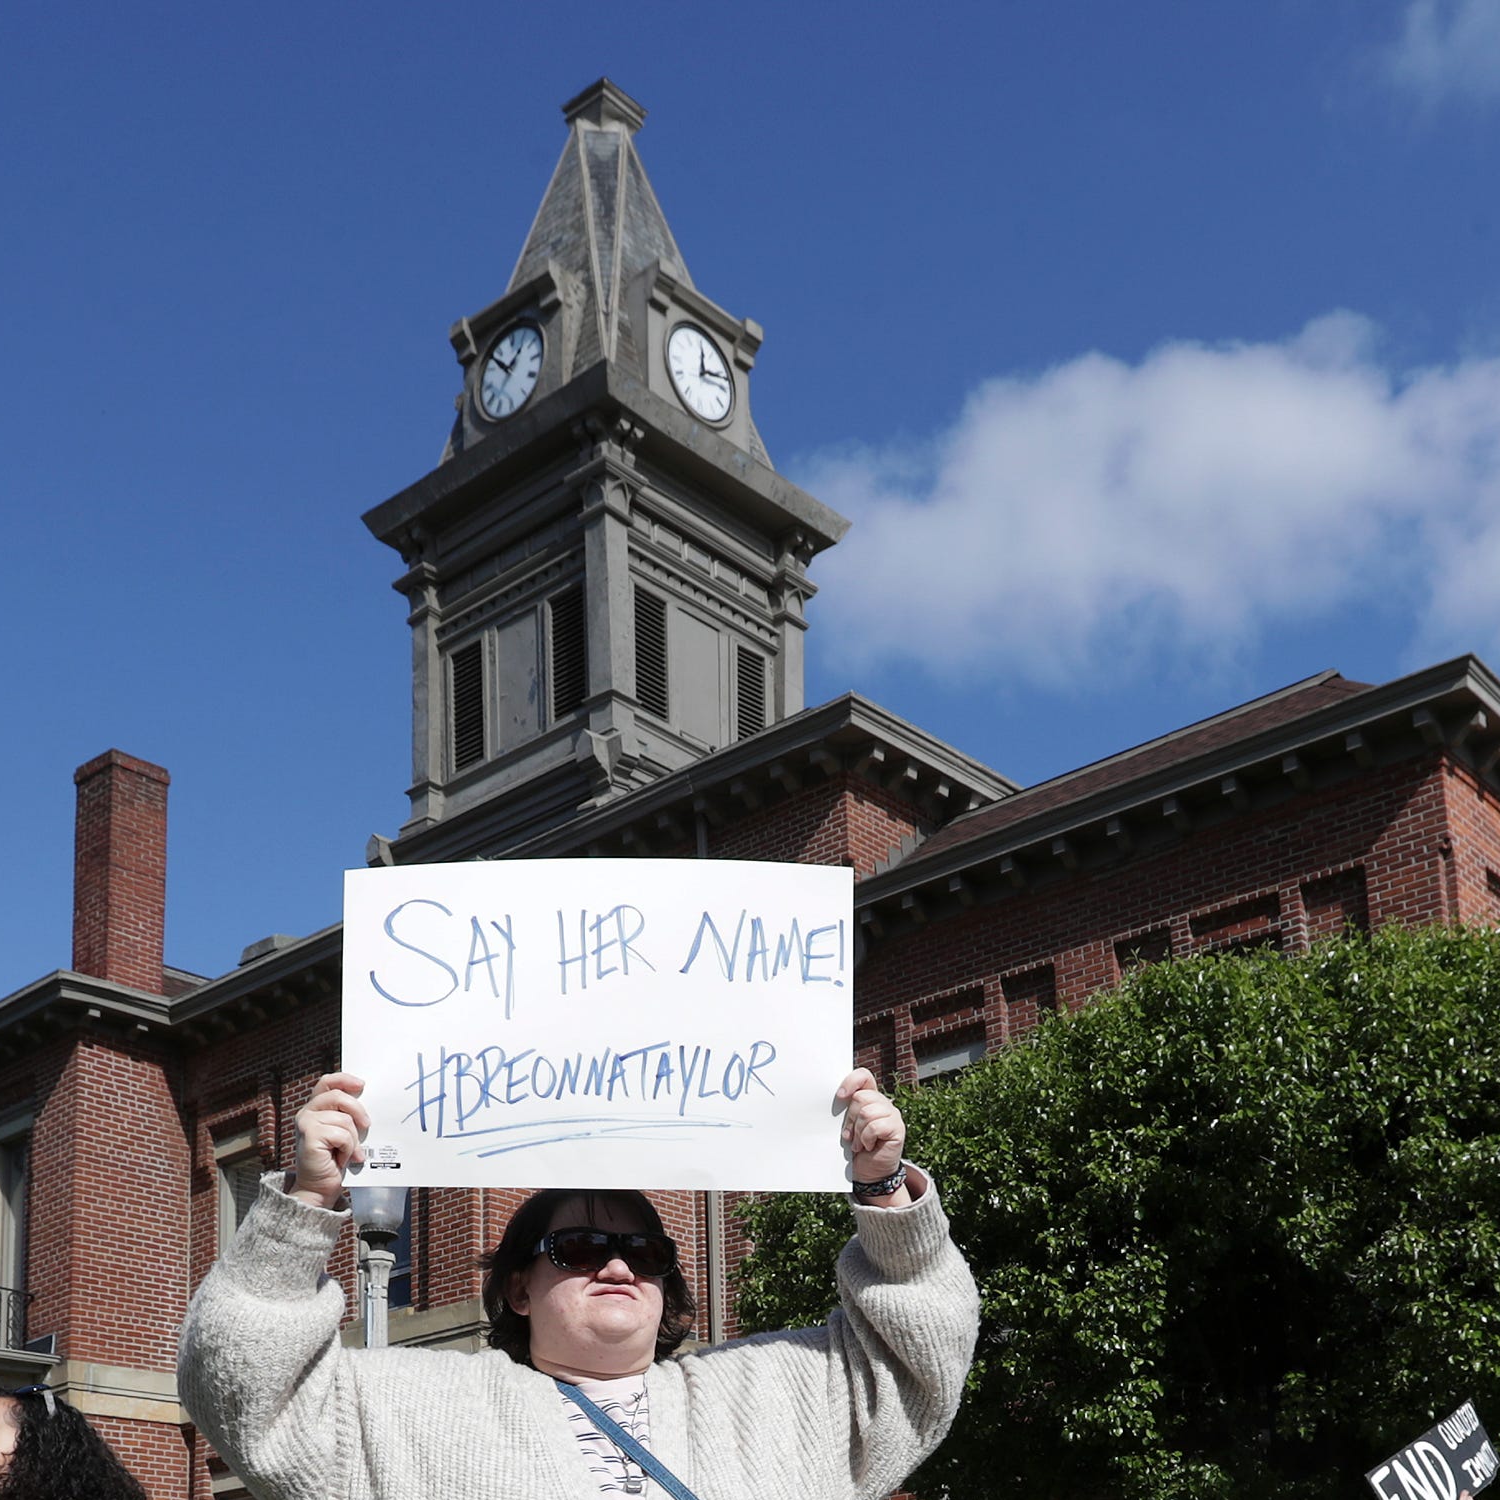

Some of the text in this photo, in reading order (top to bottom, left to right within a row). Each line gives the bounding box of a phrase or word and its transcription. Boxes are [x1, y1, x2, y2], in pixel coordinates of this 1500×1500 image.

[369, 899, 845, 1020] SAY HER NAME!
[401, 1040, 777, 1139] #BREONNATAYLOR
